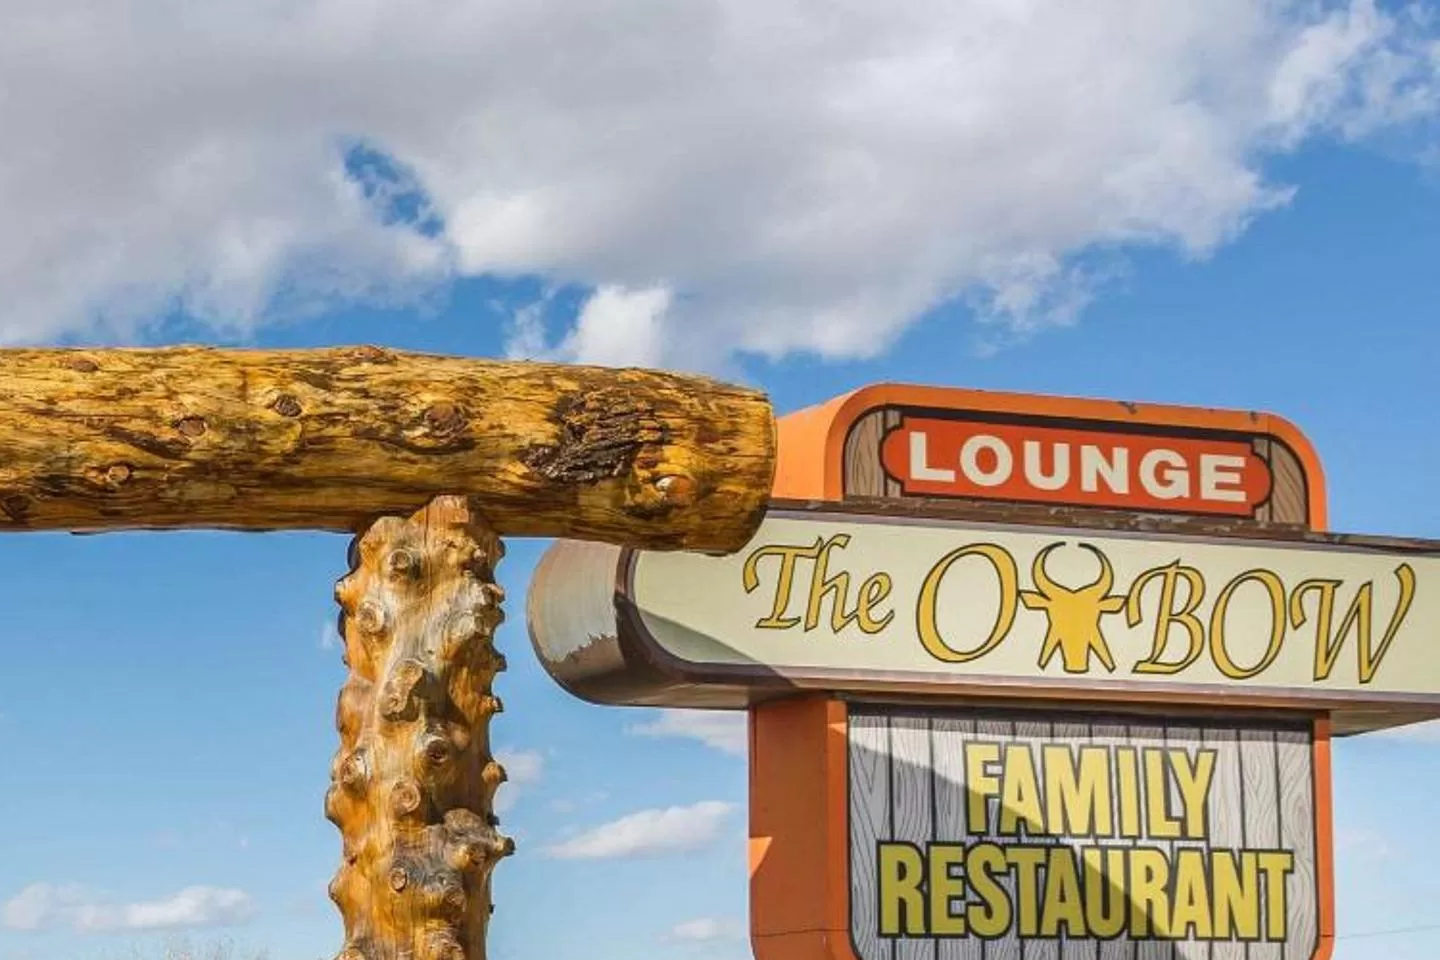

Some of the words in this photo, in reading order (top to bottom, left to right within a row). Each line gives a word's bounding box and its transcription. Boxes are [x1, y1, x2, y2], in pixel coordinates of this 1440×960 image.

[907, 430, 1249, 503] LOUNGE
[742, 532, 896, 635] The
[962, 739, 1218, 841] FAMILY
[876, 840, 1296, 943] RESTAURANT
